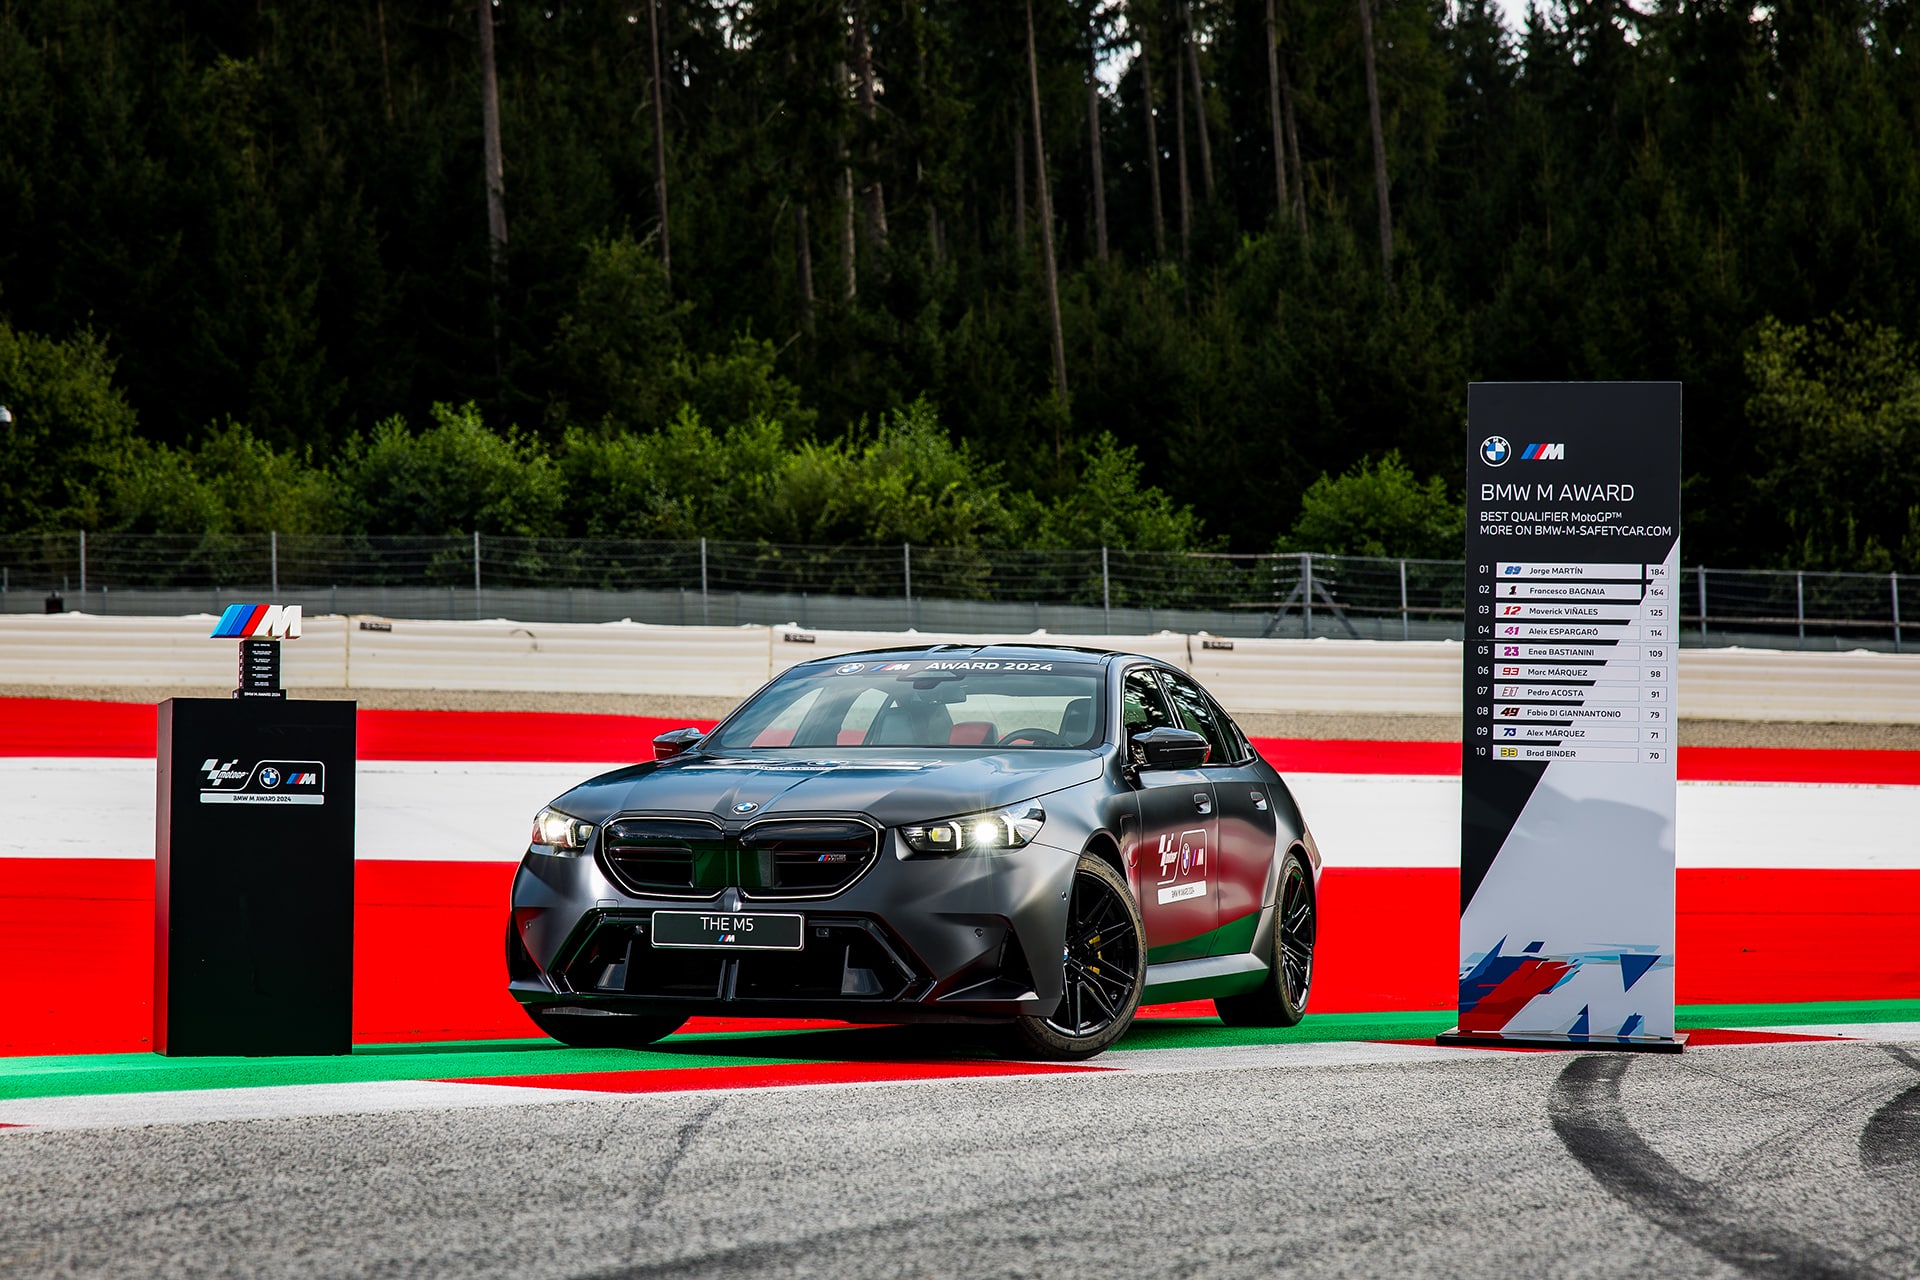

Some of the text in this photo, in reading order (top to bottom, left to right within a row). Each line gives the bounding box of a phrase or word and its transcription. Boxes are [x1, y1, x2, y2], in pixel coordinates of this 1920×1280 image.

[1481, 483, 1635, 502] BMW M AWARD
[1480, 511, 1508, 522] BEST
[1511, 512, 1569, 523] QUALIFIER
[1480, 525, 1672, 537] MORE ON BMW-M-SAFETYCAR.COM
[1479, 565, 1489, 574] 01
[1504, 566, 1522, 575] 89
[1529, 567, 1550, 576] Jorge
[1651, 568, 1665, 576] 184
[1478, 585, 1490, 594] 02
[1508, 585, 1517, 595] 1
[1529, 587, 1567, 595] Francesco
[1569, 587, 1606, 595] BAGNAIA
[1478, 605, 1663, 617] 03 12 Maverick VIÑALES 125
[1478, 625, 1490, 634] 04
[1504, 626, 1520, 636] 41
[1528, 627, 1548, 635] Aleix
[1477, 645, 1663, 658] 05 23 Enea BASTIANINI 109
[925, 662, 1000, 671] AWARD
[1002, 662, 1053, 671] 2024
[1477, 666, 1489, 675] 06
[1502, 667, 1520, 676] 93
[1528, 668, 1546, 676] Marc
[1650, 670, 1661, 678] 98
[1477, 686, 1488, 695] 07
[1527, 689, 1550, 697] Pedro
[1551, 689, 1584, 697] ACOSTA
[1650, 690, 1660, 698] 91
[1476, 706, 1660, 719] 08 49 Fabio DI GIANNANTONIO 79
[1476, 726, 1488, 735] 09
[1503, 727, 1517, 736] 73
[1526, 729, 1544, 737] Alex
[1650, 731, 1659, 739] 71
[1475, 747, 1660, 760] 10 33 Brad BINDER 70
[700, 916, 754, 932] THE M5
